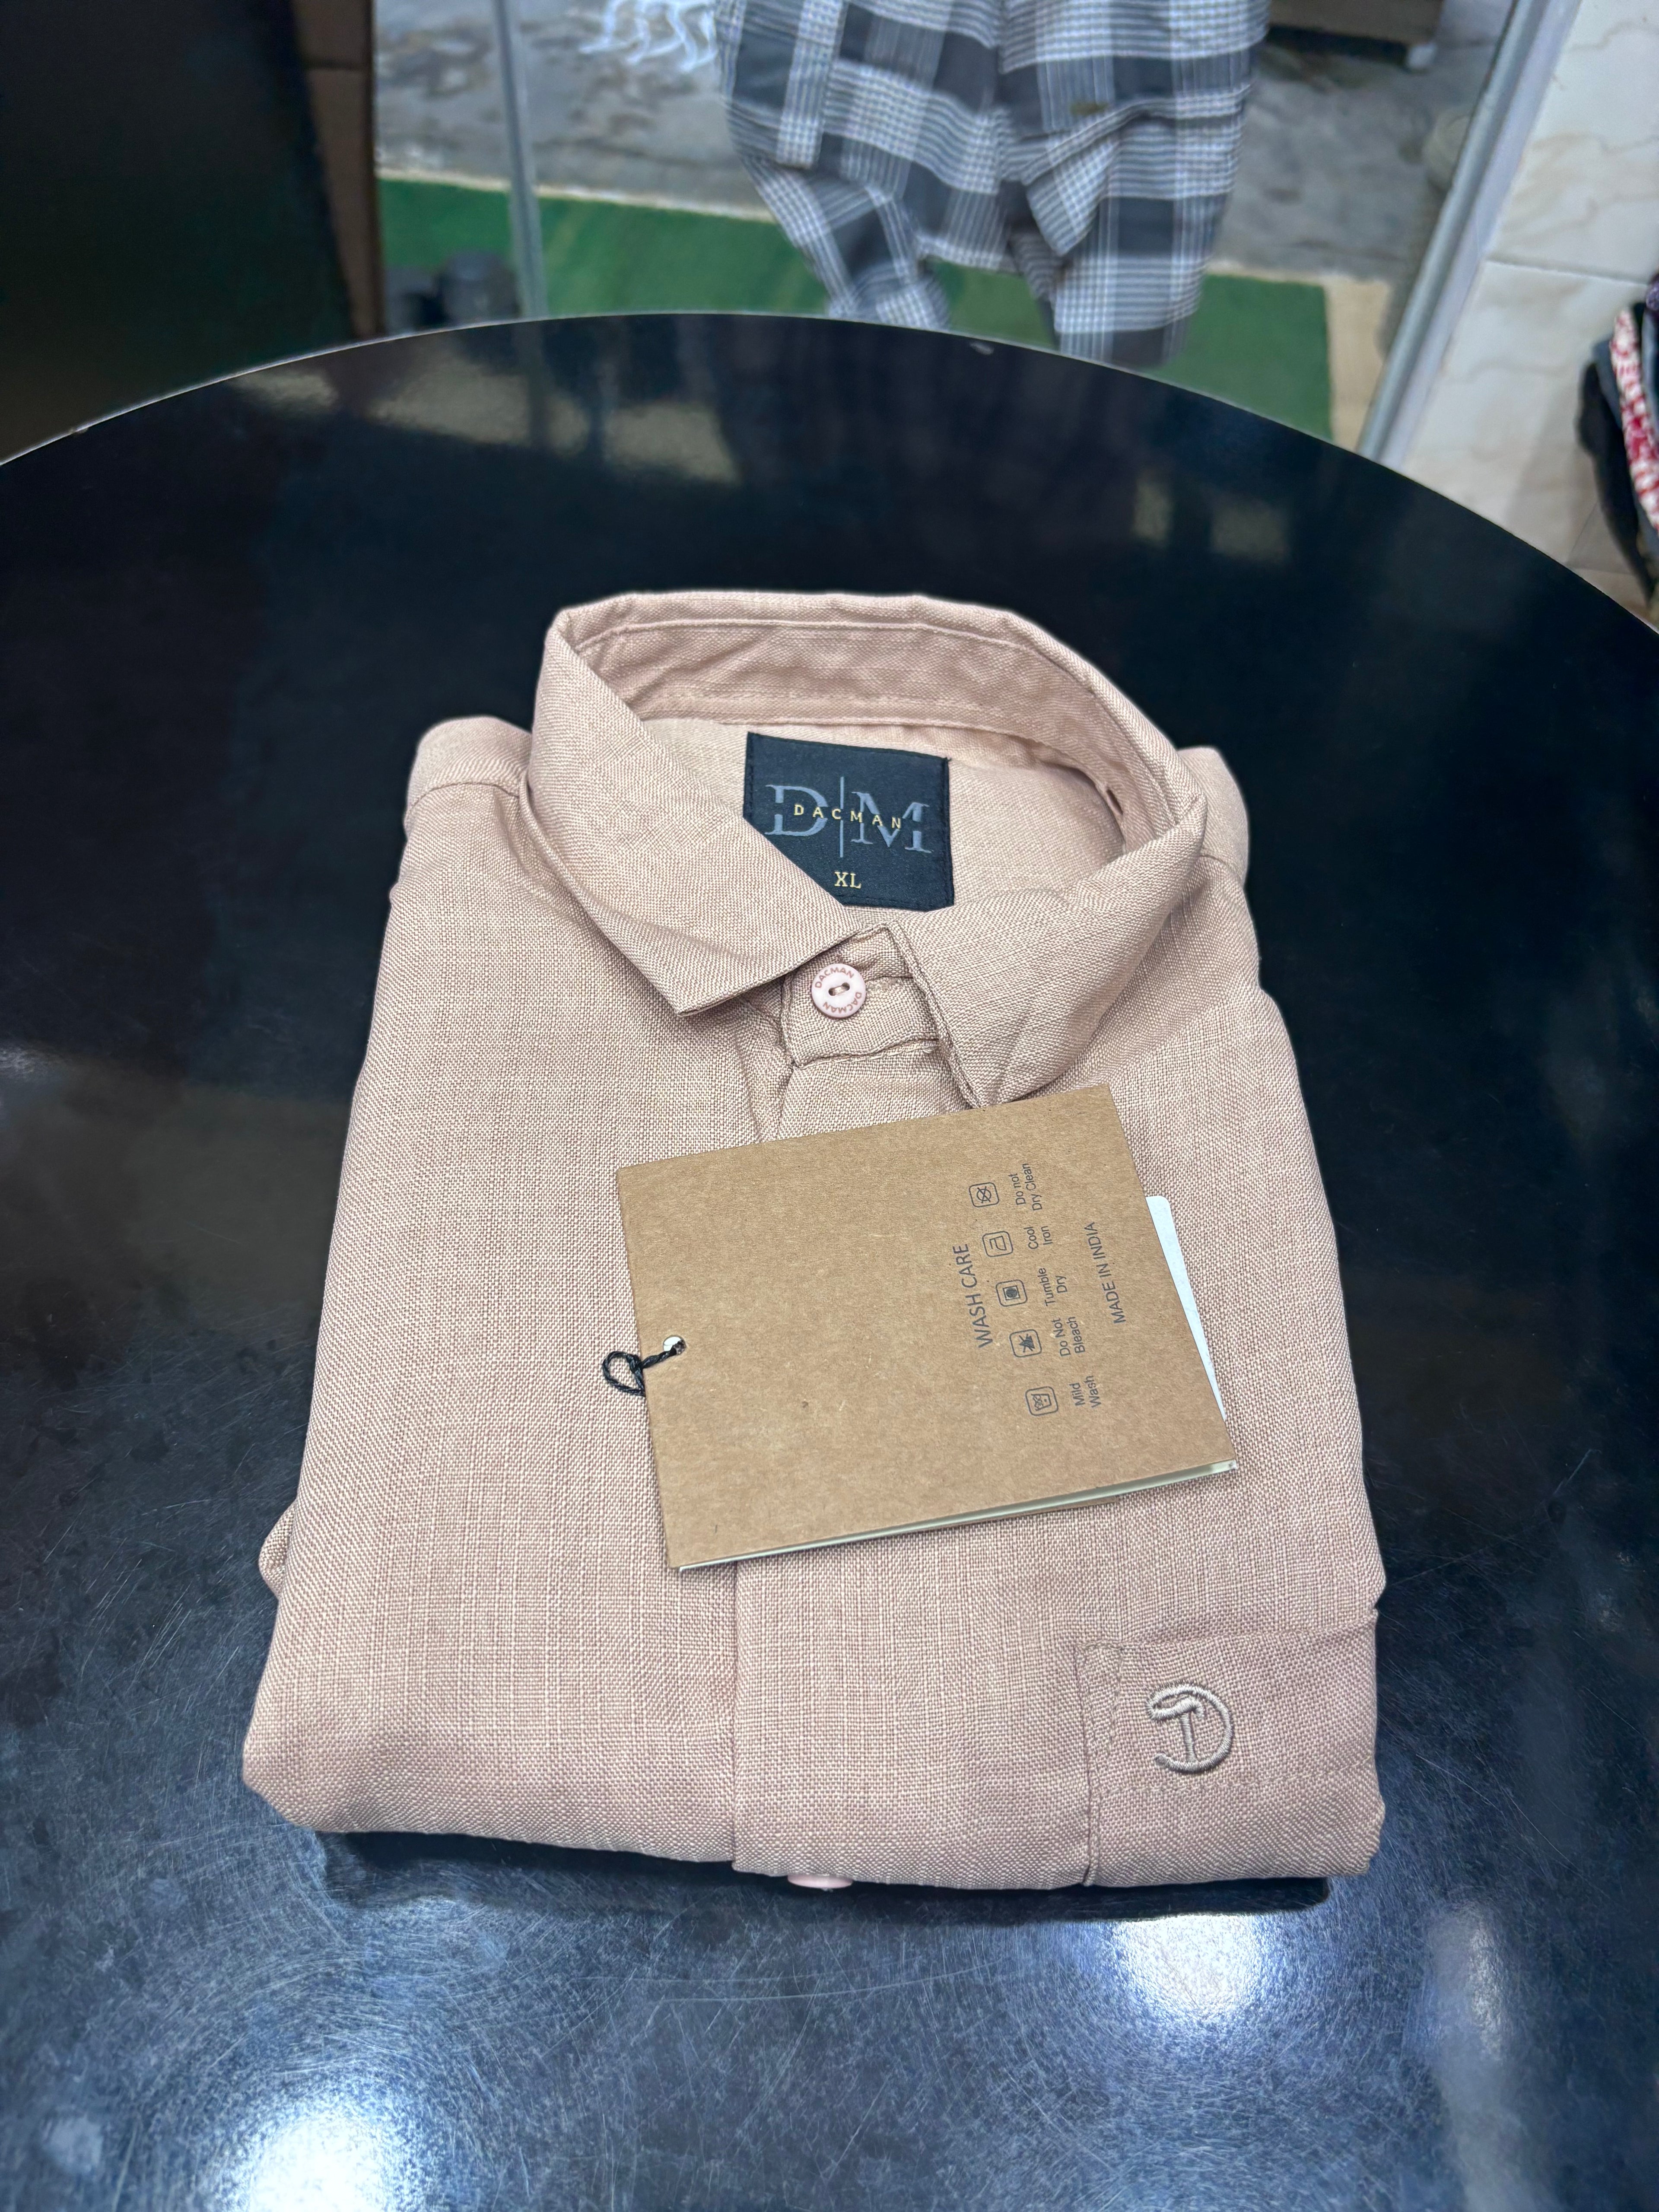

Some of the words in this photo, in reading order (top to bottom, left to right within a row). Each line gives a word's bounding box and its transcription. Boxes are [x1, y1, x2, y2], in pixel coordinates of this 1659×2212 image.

[794, 804, 901, 829] DACMAN
[834, 871, 861, 889] XL
[815, 967, 854, 988] DACMAN
[823, 992, 862, 1014] DACMAN
[1009, 1174, 1020, 1188] not
[1022, 1163, 1036, 1191] Clean
[1015, 1191, 1027, 1205] Do
[1032, 1194, 1042, 1211] Dry
[1024, 1226, 1039, 1249] Cool
[1040, 1226, 1053, 1245] Iron
[1084, 1222, 1106, 1260] INDIA
[953, 1244, 978, 1288] CARE
[1095, 1264, 1112, 1278] IN
[1037, 1267, 1056, 1306] Tumble
[1055, 1275, 1068, 1294] Dry
[1102, 1280, 1125, 1324] MADE
[965, 1293, 993, 1348] WASH
[1051, 1317, 1065, 1338] Not
[1067, 1316, 1086, 1354] Bleach
[1059, 1340, 1071, 1357] Do
[1069, 1382, 1085, 1407] Mild
[1084, 1376, 1102, 1408] Wash
